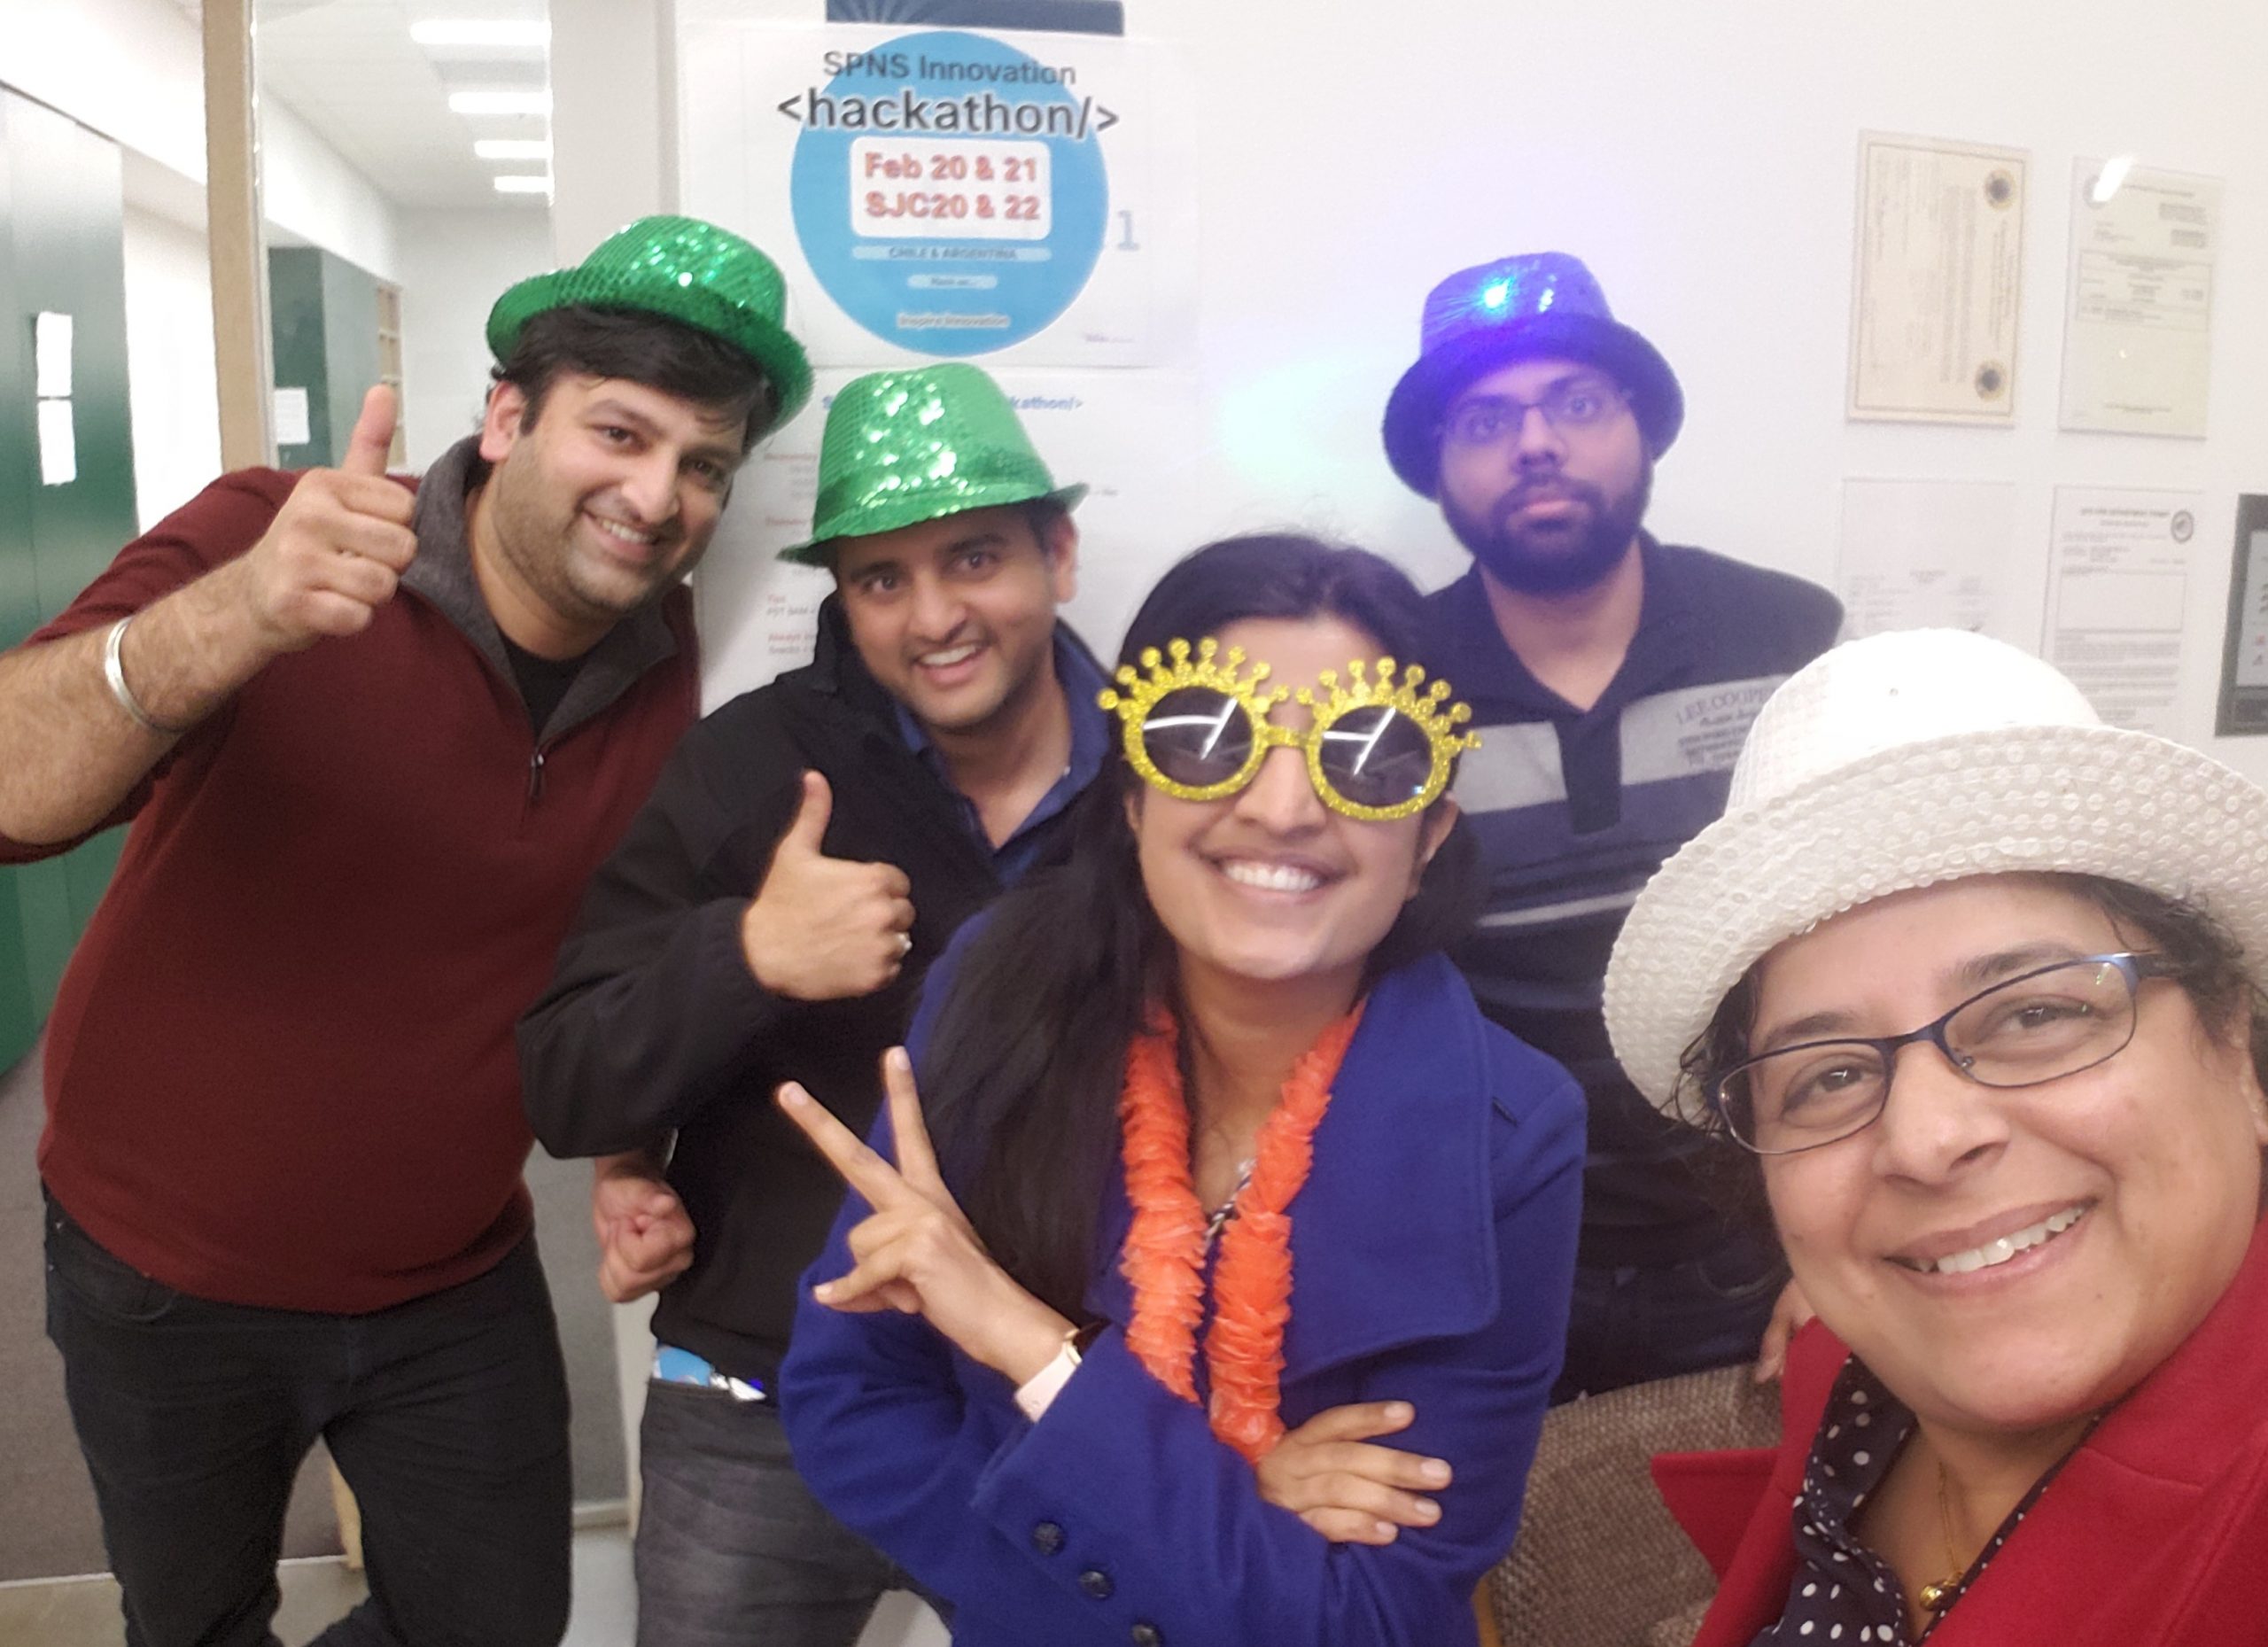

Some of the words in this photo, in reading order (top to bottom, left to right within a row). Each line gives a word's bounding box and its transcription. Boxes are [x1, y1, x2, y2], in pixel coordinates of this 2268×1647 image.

[823, 50, 910, 79] SPNS
[920, 54, 1077, 85] Innovation
[777, 87, 1119, 139] <hackathon/>
[865, 151, 923, 178] Feb
[929, 154, 967, 181] 20
[975, 155, 994, 181] &
[1003, 156, 1037, 182] 21
[866, 190, 968, 219] SJC20
[975, 193, 994, 219] &
[1003, 194, 1040, 220] 22
[889, 246, 928, 259] CHILE
[942, 247, 1017, 260] ARGENTINA
[944, 315, 1008, 329] Innovation
